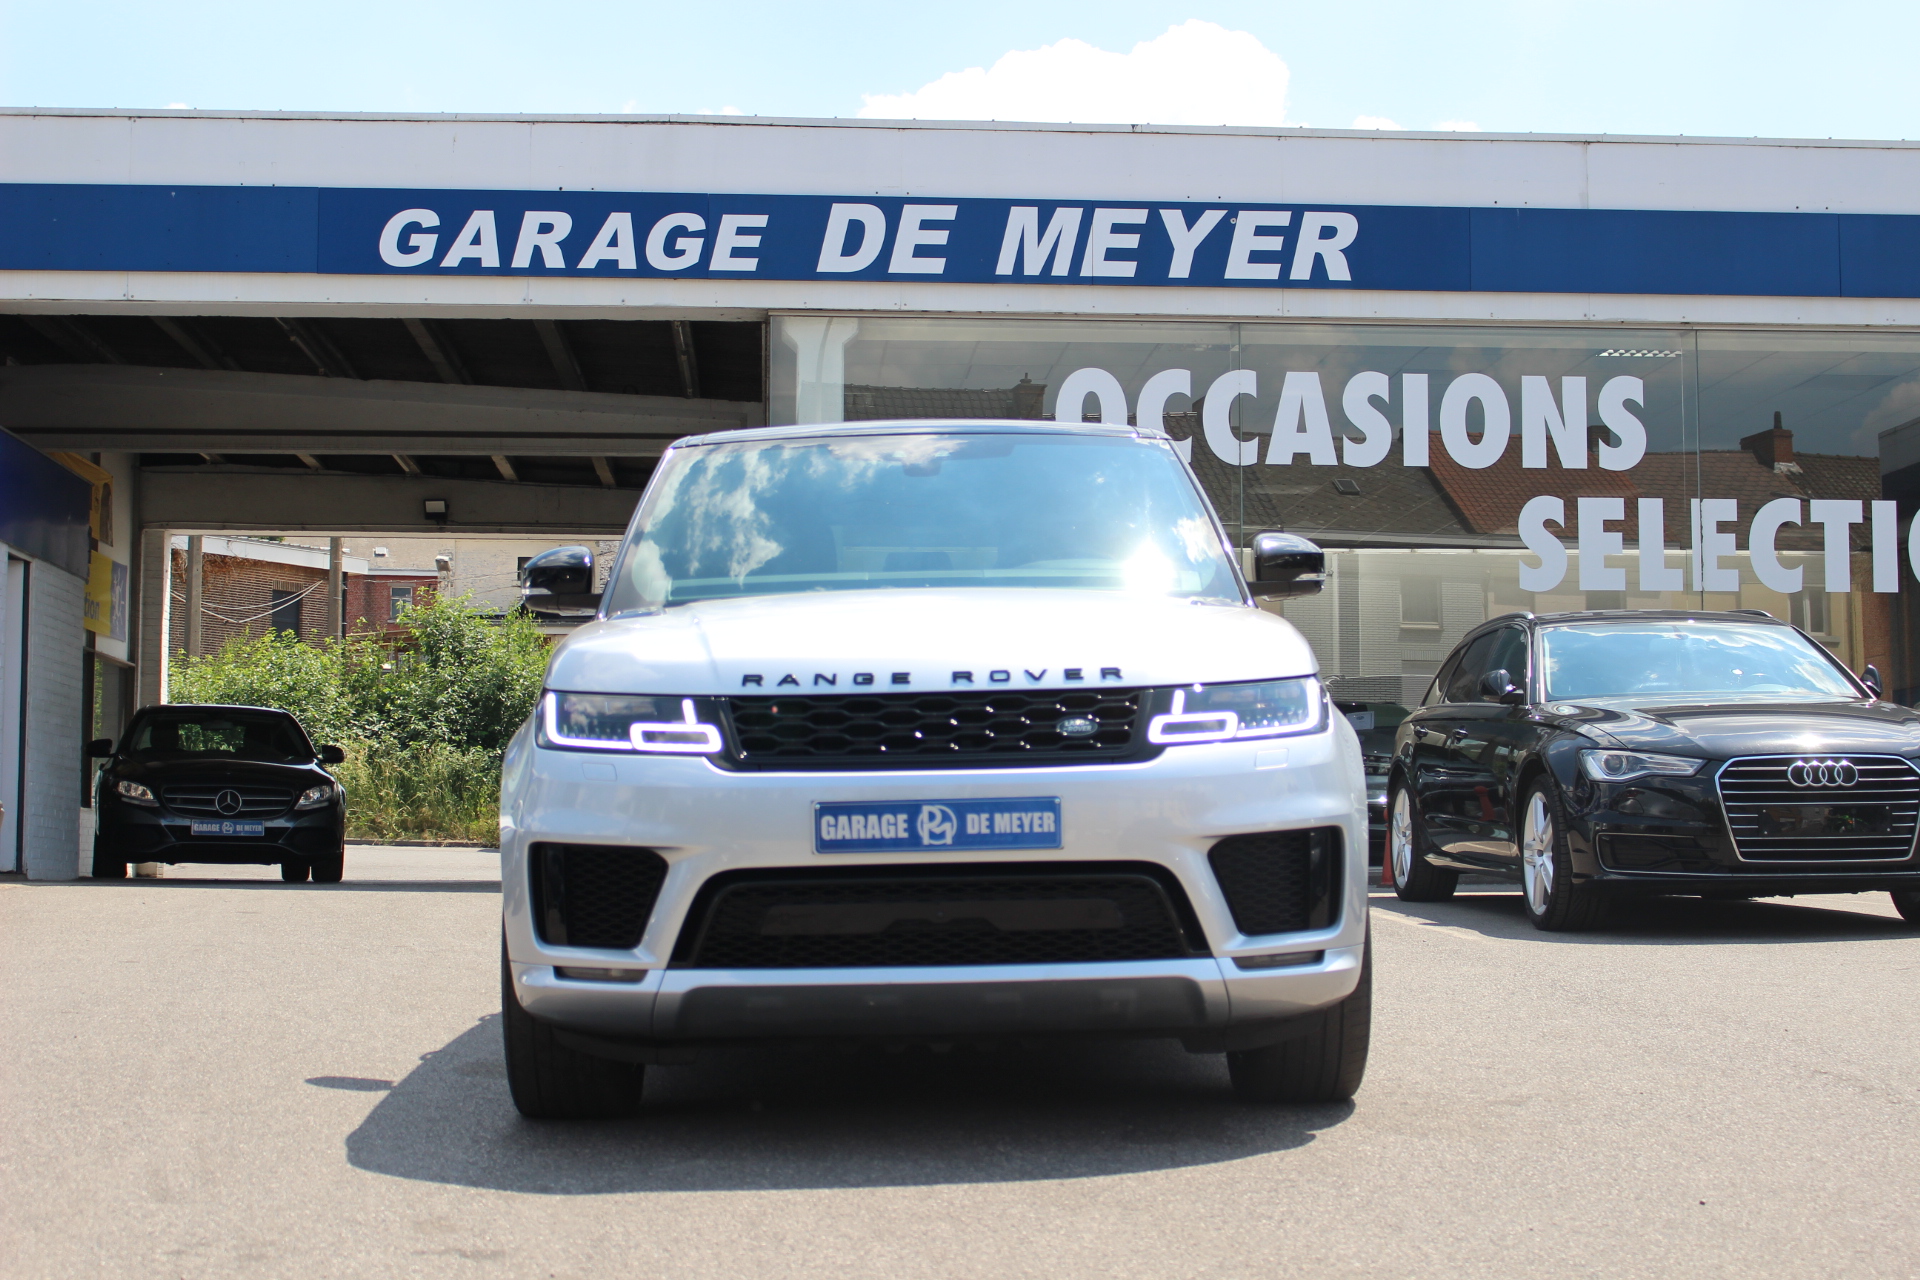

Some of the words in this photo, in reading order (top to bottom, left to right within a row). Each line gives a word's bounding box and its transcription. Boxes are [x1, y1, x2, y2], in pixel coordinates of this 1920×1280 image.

[379, 208, 769, 272] GARAGE
[816, 203, 959, 275] DE
[995, 205, 1360, 282] MEYER
[1518, 495, 1920, 594] SELECTI
[741, 672, 911, 687] RANGE
[952, 667, 1123, 684] ROVER
[194, 823, 220, 832] GARAGE
[236, 824, 243, 832] DE
[820, 814, 909, 841] GARAGE
[966, 813, 991, 835] DE
[994, 812, 1056, 834] MEYER
